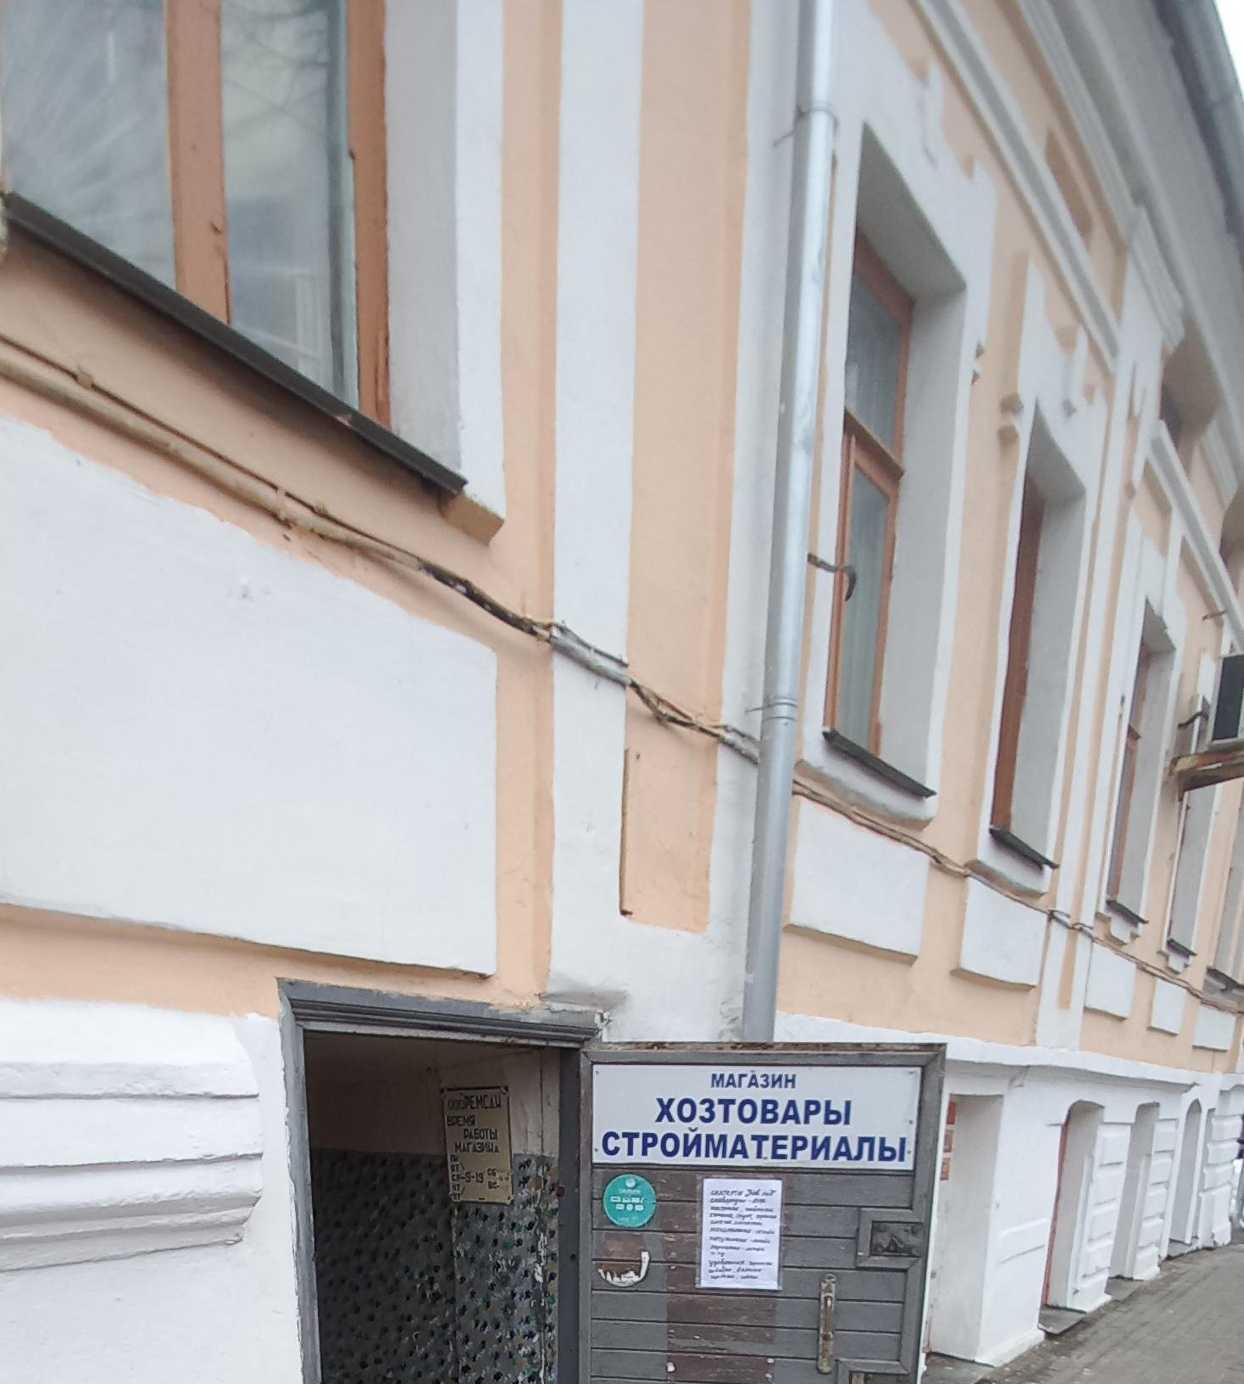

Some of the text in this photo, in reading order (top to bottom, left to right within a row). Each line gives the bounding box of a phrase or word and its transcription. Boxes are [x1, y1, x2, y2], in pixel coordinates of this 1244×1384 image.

[711, 1073, 797, 1089] МАГАЗИН
[655, 1097, 852, 1126] ХОЗТОВАРЫ
[463, 1128, 498, 1140] РАБОТЫ
[601, 1127, 907, 1162] СТРОЙМАТЕРИАЛЫ
